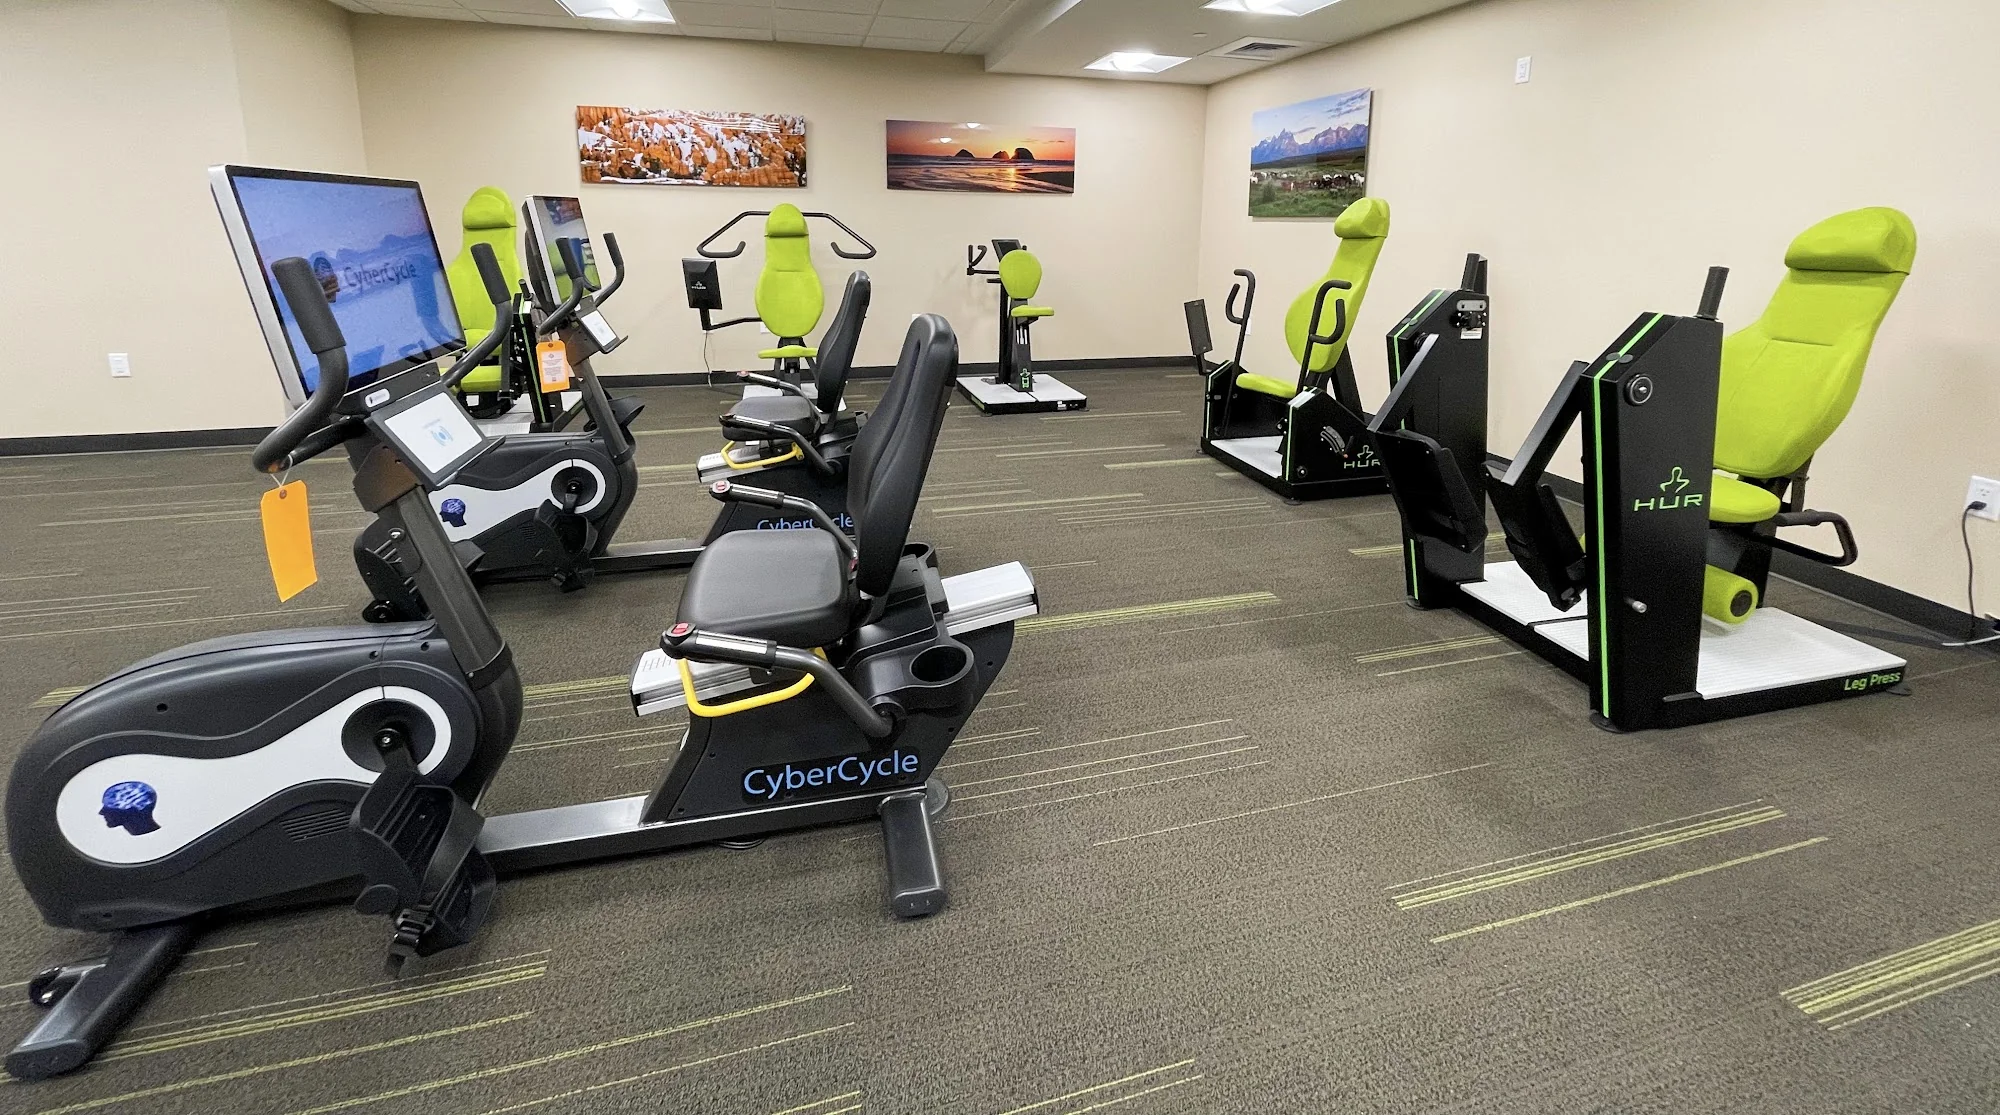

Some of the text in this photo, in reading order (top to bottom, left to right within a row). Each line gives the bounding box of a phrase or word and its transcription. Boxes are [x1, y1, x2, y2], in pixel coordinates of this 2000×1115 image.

[1633, 493, 1703, 512] HUR
[1844, 672, 1902, 691] Leg Press
[743, 750, 919, 800] CyberCycle
